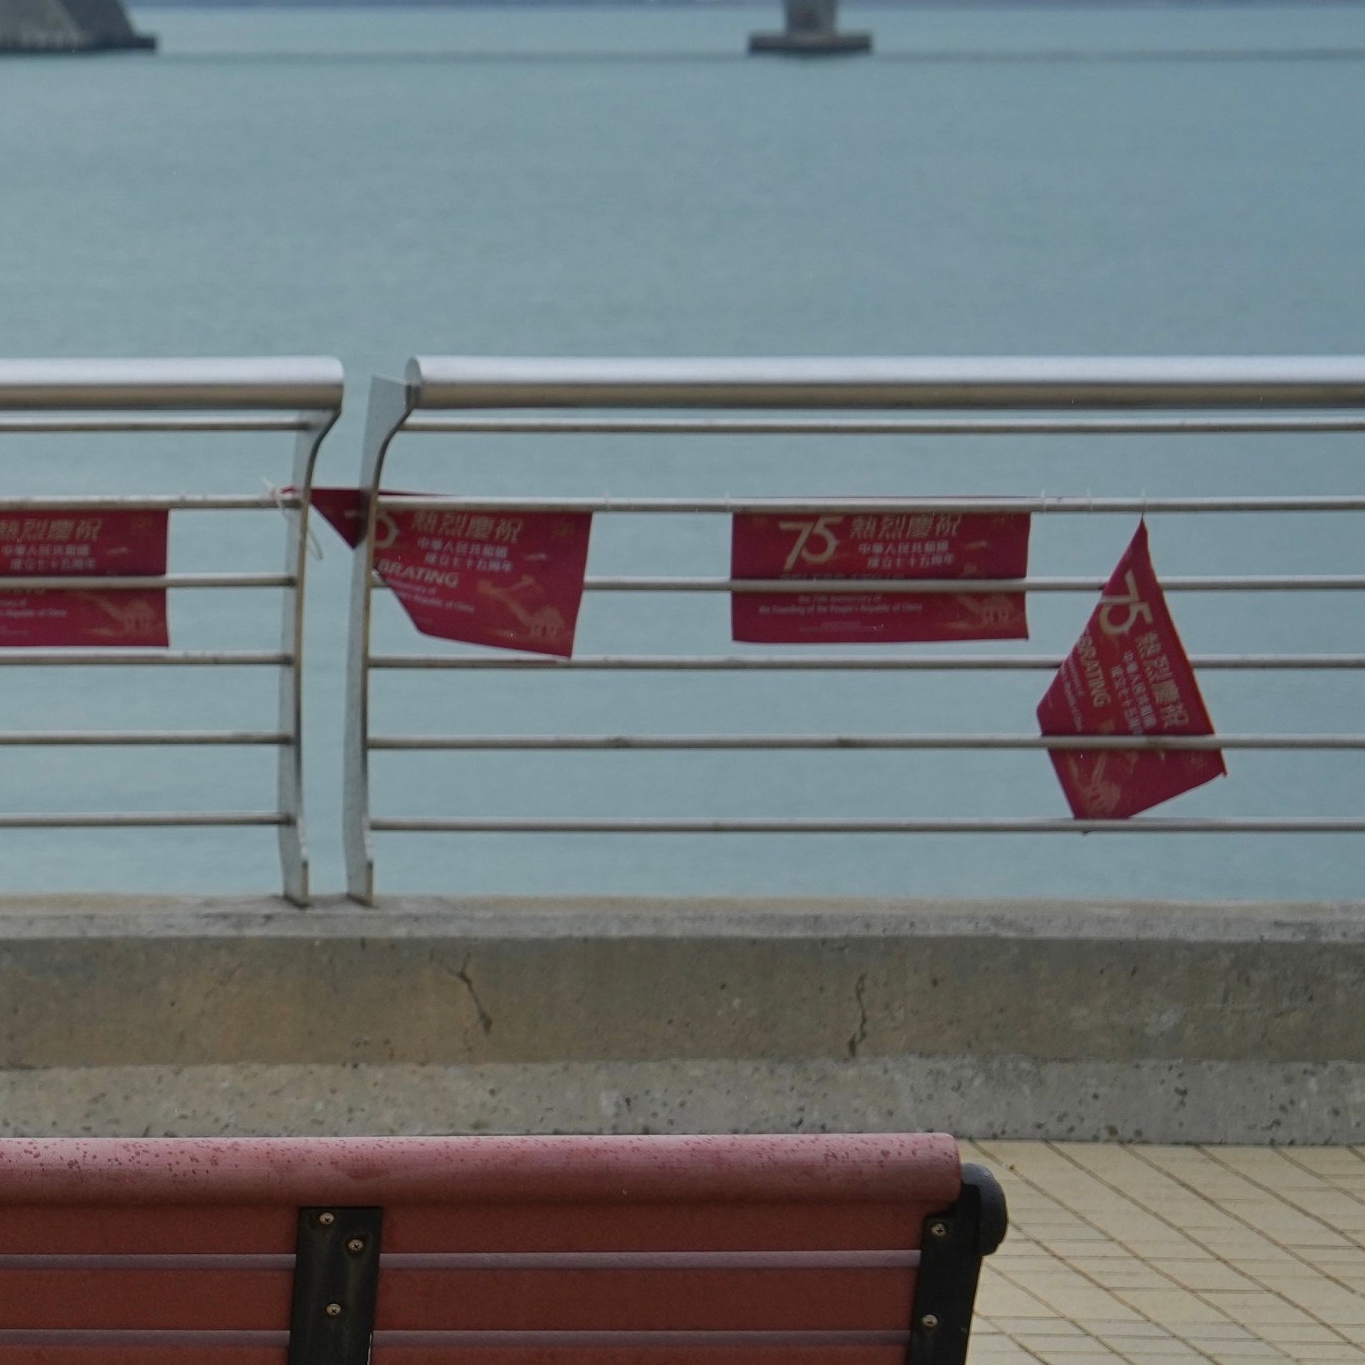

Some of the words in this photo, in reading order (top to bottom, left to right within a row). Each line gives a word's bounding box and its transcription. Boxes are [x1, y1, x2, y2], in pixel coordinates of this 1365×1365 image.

[411, 511, 524, 545] 熱烈慶祝
[778, 515, 844, 571] 75
[850, 513, 962, 540] 熱烈慶祝
[376, 558, 460, 588] BRATING
[1099, 569, 1154, 635] 75
[1077, 634, 1111, 708] BRATING
[1135, 631, 1190, 727] 熱烈慶祝
